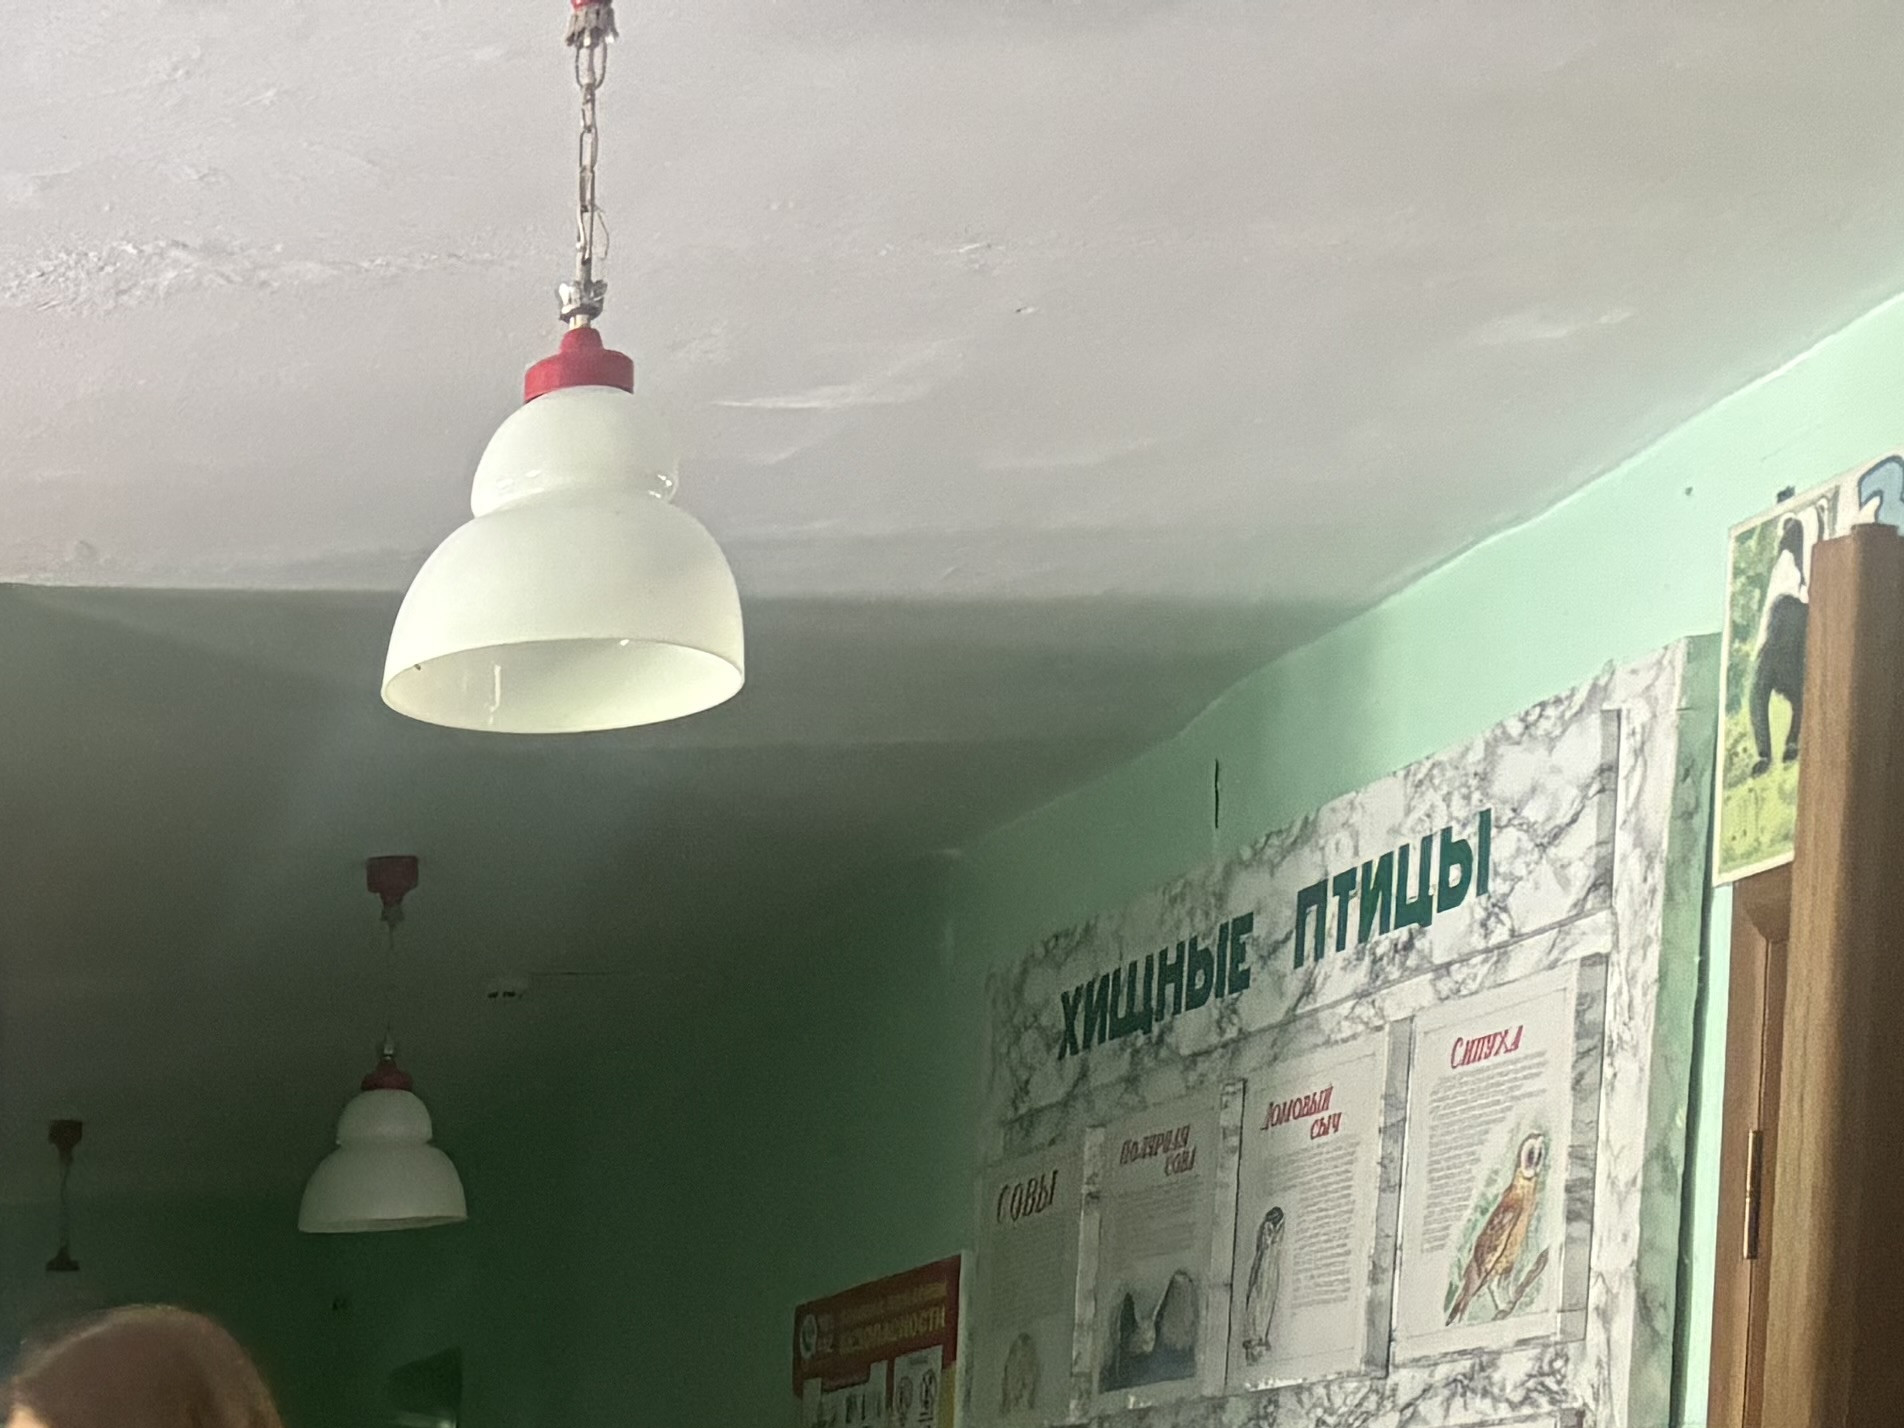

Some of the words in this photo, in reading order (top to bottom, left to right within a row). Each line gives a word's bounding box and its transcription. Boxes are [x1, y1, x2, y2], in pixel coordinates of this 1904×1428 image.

[1057, 911, 1254, 1061] ХИЩНЫЕ
[1294, 808, 1492, 970] ПТИЦЫ
[1451, 1025, 1523, 1069] СИПУХА
[1310, 1112, 1342, 1140] СЫЧ
[997, 1170, 1058, 1222] СОВЫ
